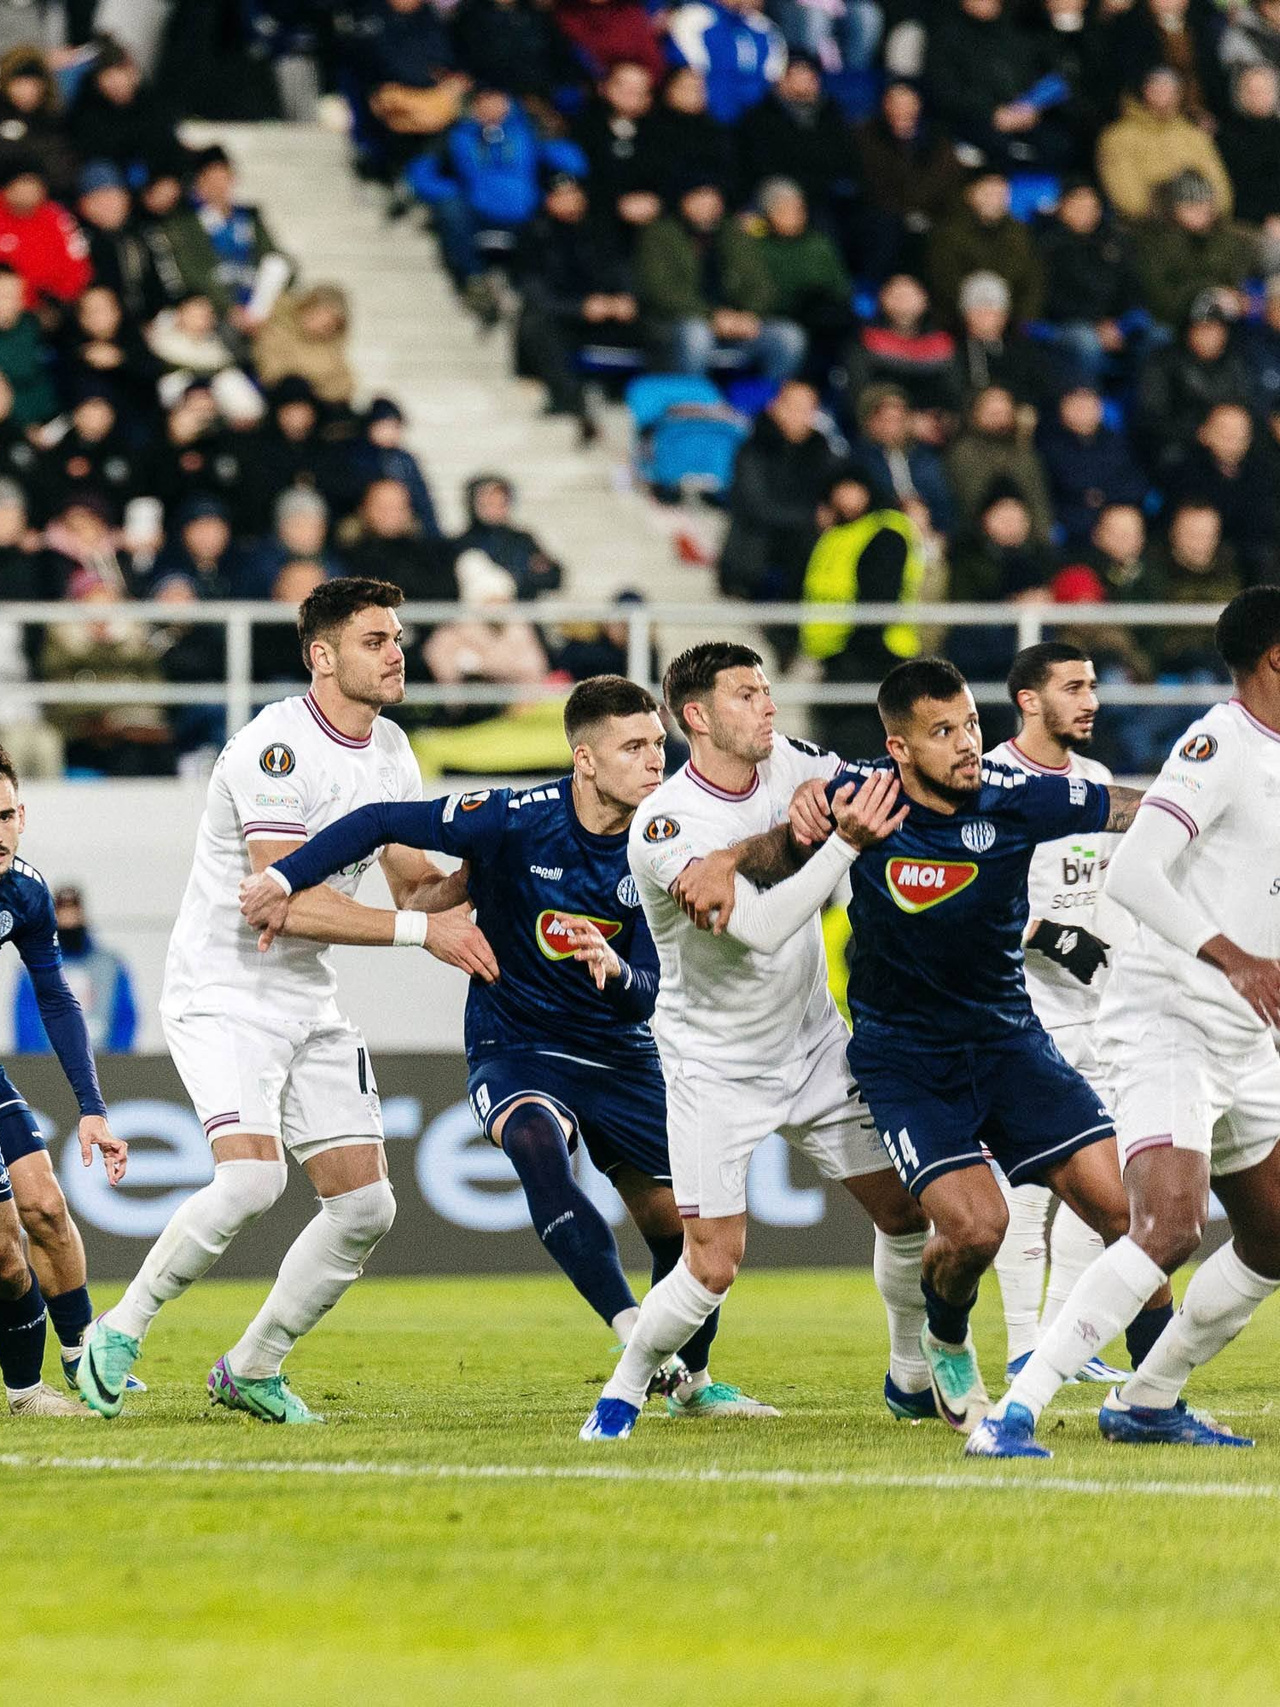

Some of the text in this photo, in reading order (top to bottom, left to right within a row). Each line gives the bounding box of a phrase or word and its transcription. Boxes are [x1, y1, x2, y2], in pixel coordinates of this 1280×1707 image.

[530, 864, 563, 881] capelli
[898, 865, 946, 888] MOL
[898, 1127, 920, 1170] 4
